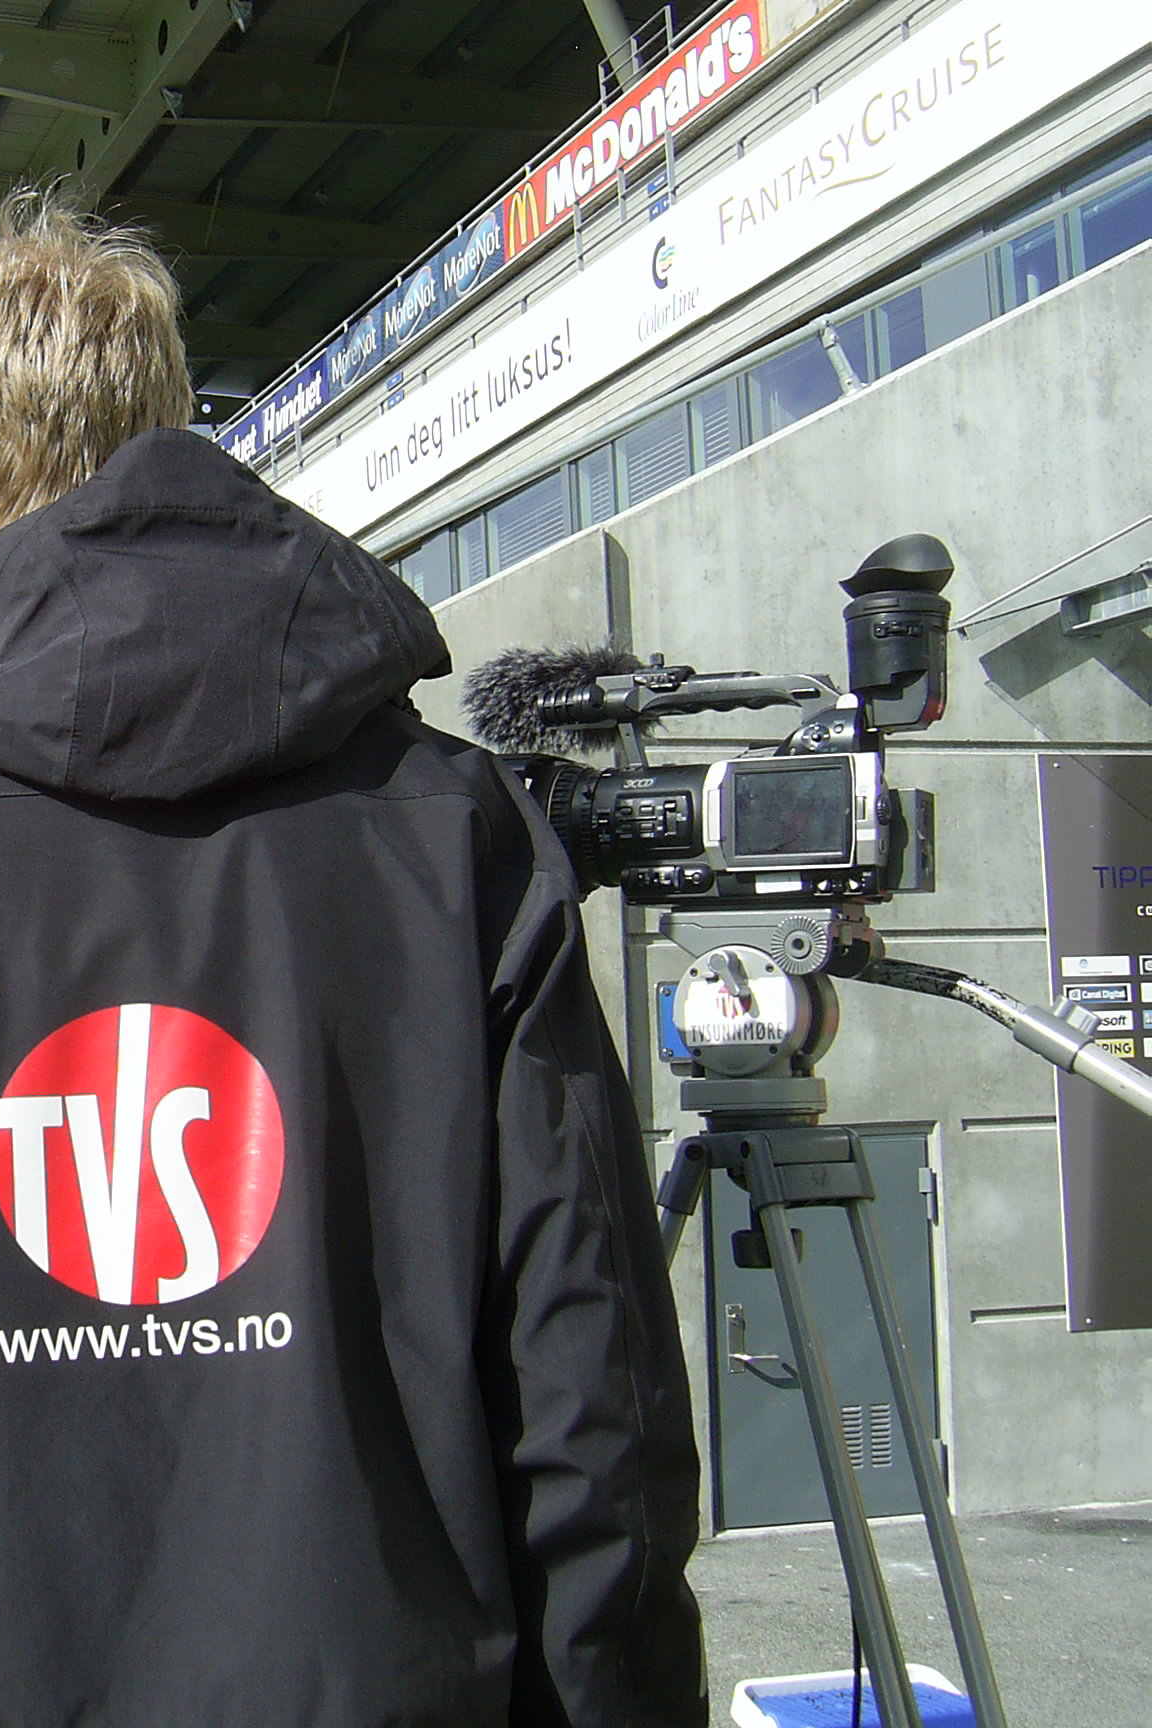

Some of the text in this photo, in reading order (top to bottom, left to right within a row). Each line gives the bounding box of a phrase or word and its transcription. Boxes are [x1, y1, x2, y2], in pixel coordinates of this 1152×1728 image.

[545, 14, 754, 225] McDonald's
[365, 317, 571, 491] Unn deg litt luksus!
